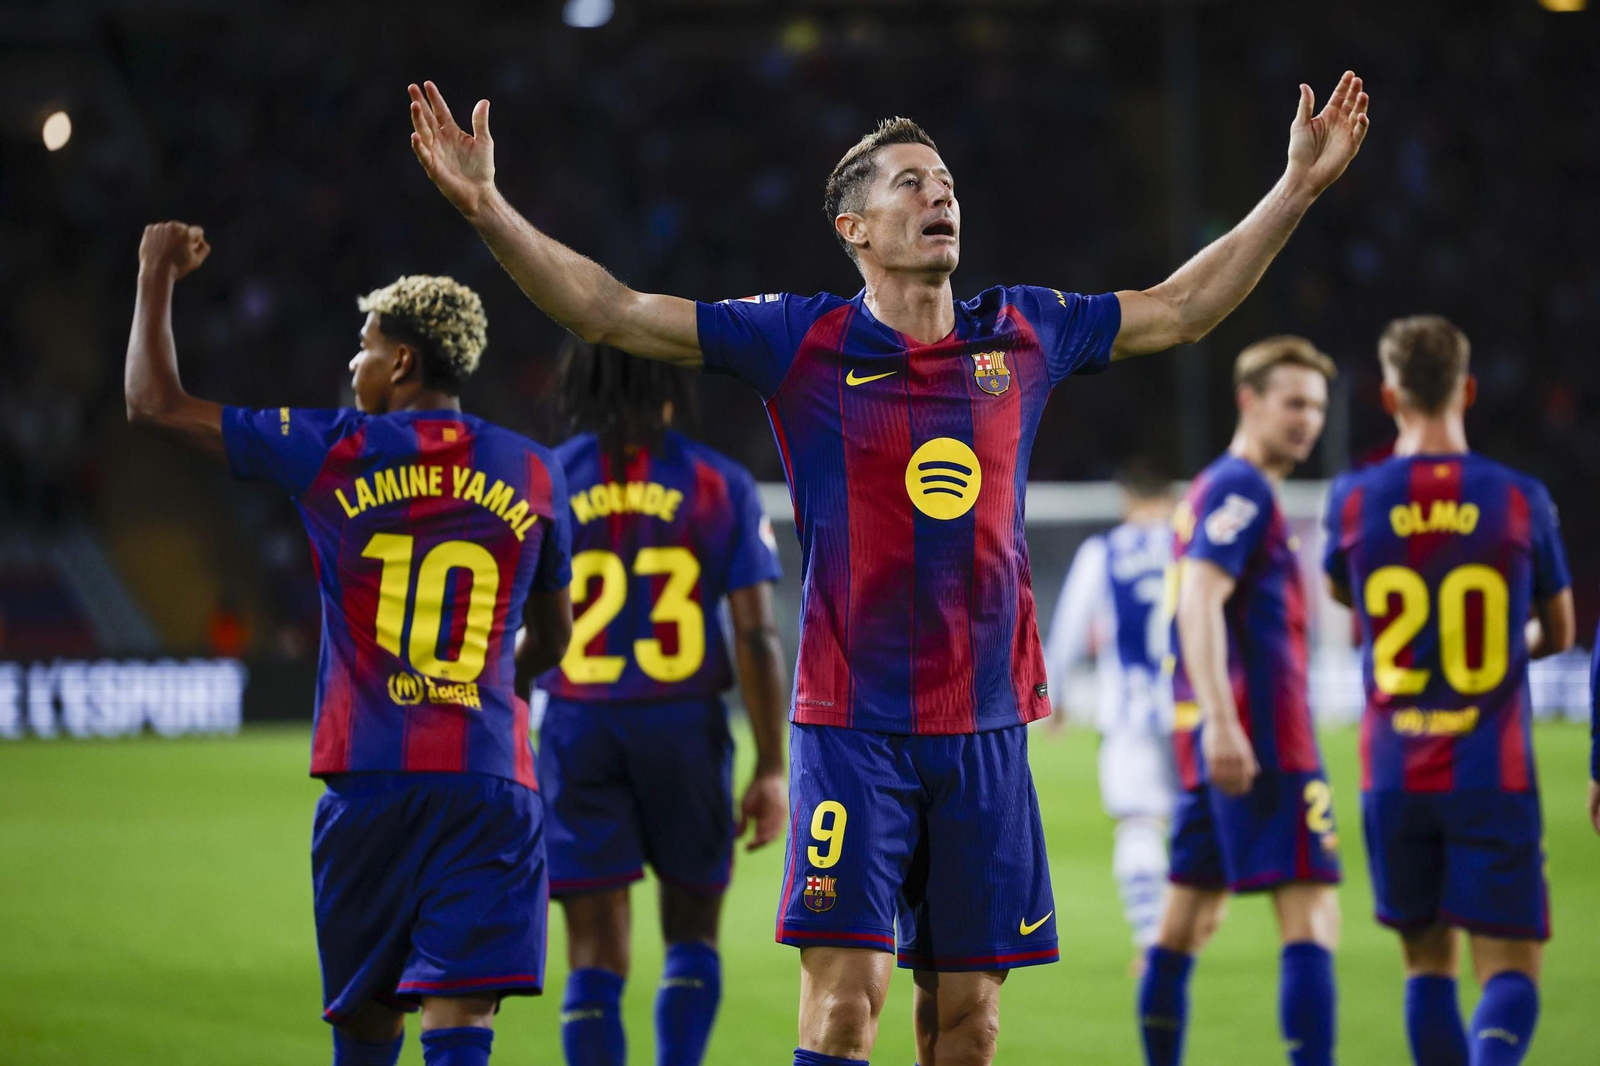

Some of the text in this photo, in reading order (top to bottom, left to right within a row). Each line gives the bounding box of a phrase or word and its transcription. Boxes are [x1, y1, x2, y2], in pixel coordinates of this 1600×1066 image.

[334, 465, 538, 543] LAMINE YAMAL
[1389, 500, 1480, 537] OLMO
[361, 532, 500, 683] 10
[559, 547, 706, 684] 23
[1364, 564, 1509, 695] 20
[807, 800, 848, 869] 9
